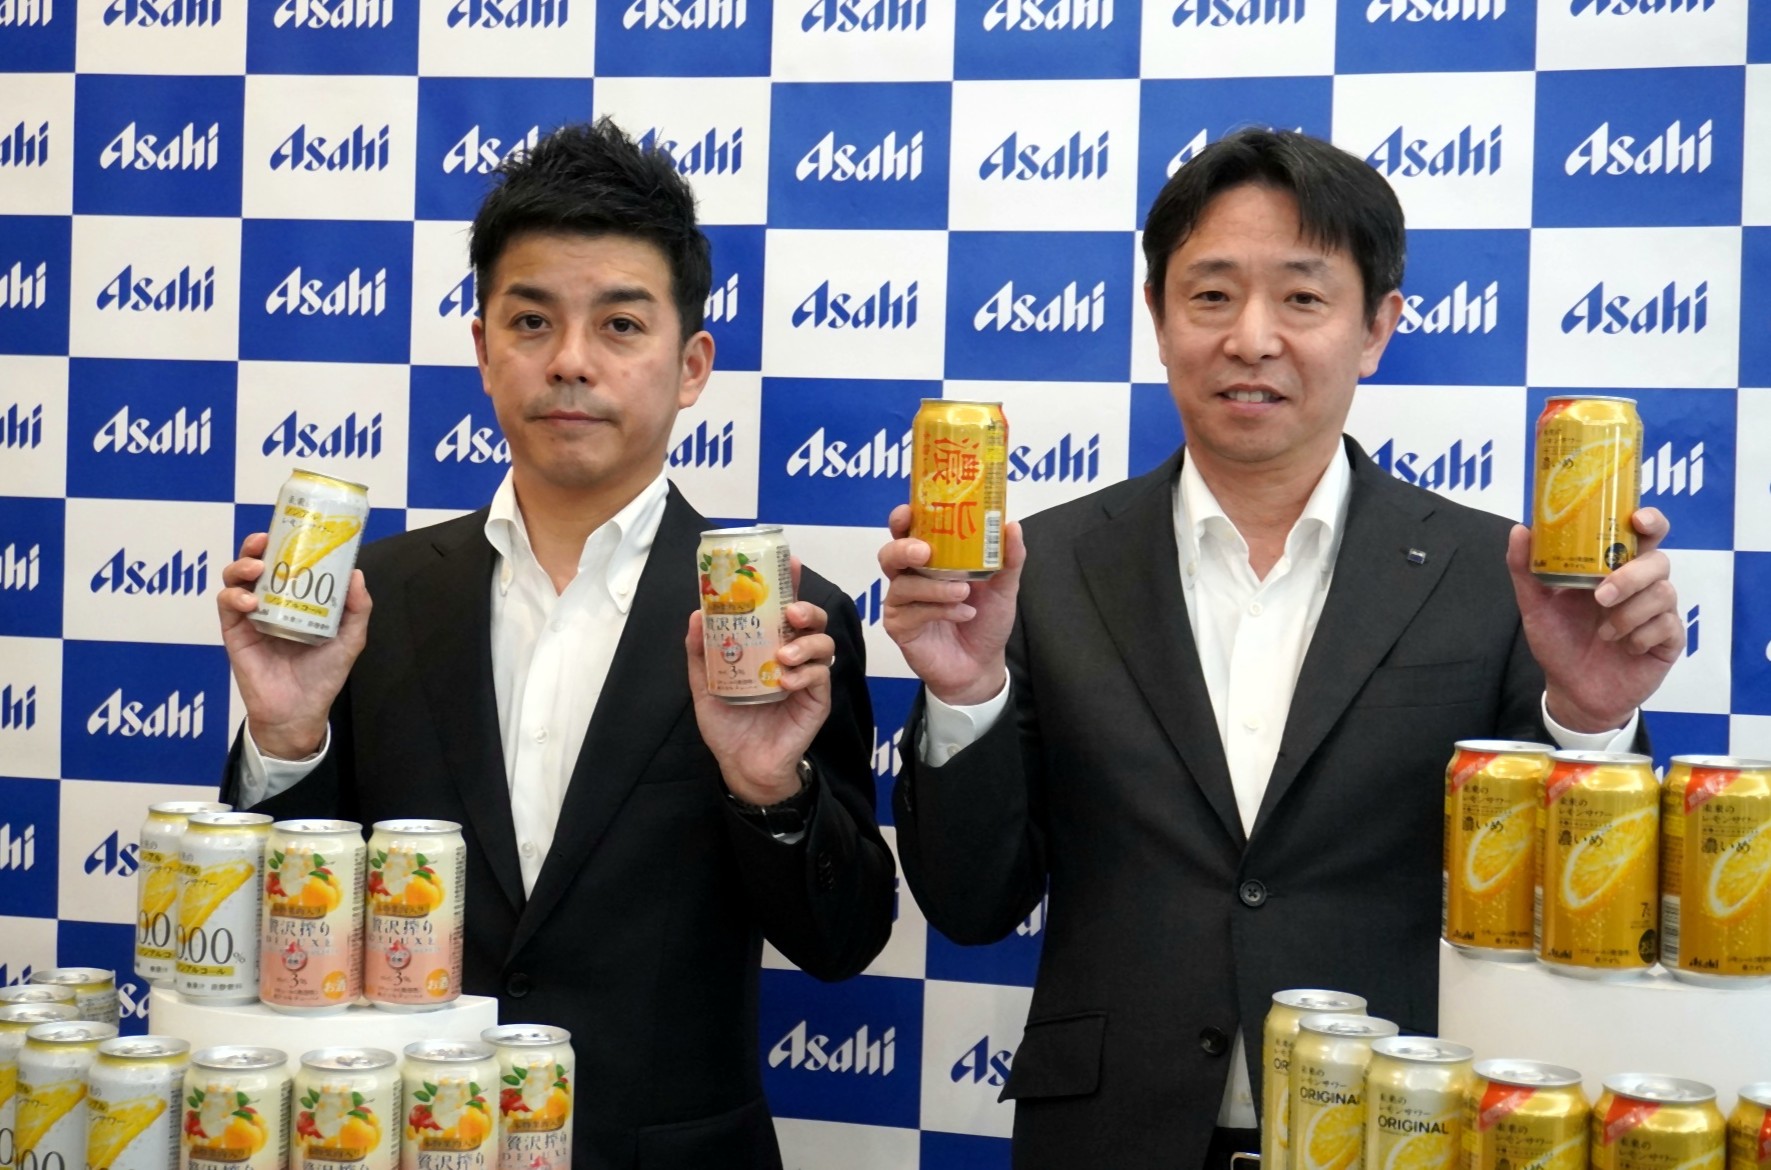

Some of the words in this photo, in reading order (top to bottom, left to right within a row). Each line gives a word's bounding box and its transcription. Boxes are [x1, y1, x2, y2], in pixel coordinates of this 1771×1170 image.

[0, 0, 53, 26] ahi
[100, 122, 219, 171] Asahi
[269, 124, 389, 171] Asahi
[443, 124, 564, 174] Asa
[796, 131, 923, 182] Asahi
[979, 131, 1109, 181] Asahi
[1364, 125, 1502, 177] Asahi
[1564, 119, 1713, 177] Asahi
[96, 265, 214, 312] Asahi
[266, 267, 386, 316] Asahi
[791, 280, 917, 329] Asahi
[973, 280, 1105, 333] Asahi
[1396, 280, 1498, 334] sahi
[1561, 281, 1708, 335] Asahi
[93, 405, 212, 455] Asahi
[262, 410, 382, 459] Asahi
[435, 414, 512, 464] Asa
[668, 420, 734, 468] ahi
[786, 426, 912, 479] Asahi
[1007, 433, 1100, 482] sahi
[90, 547, 207, 596] Asahi
[87, 688, 205, 739] Asahi
[768, 1019, 896, 1077] Asahi
[1300, 1087, 1360, 1105] ORIGINA
[1378, 1115, 1449, 1135] ORIGINAL
